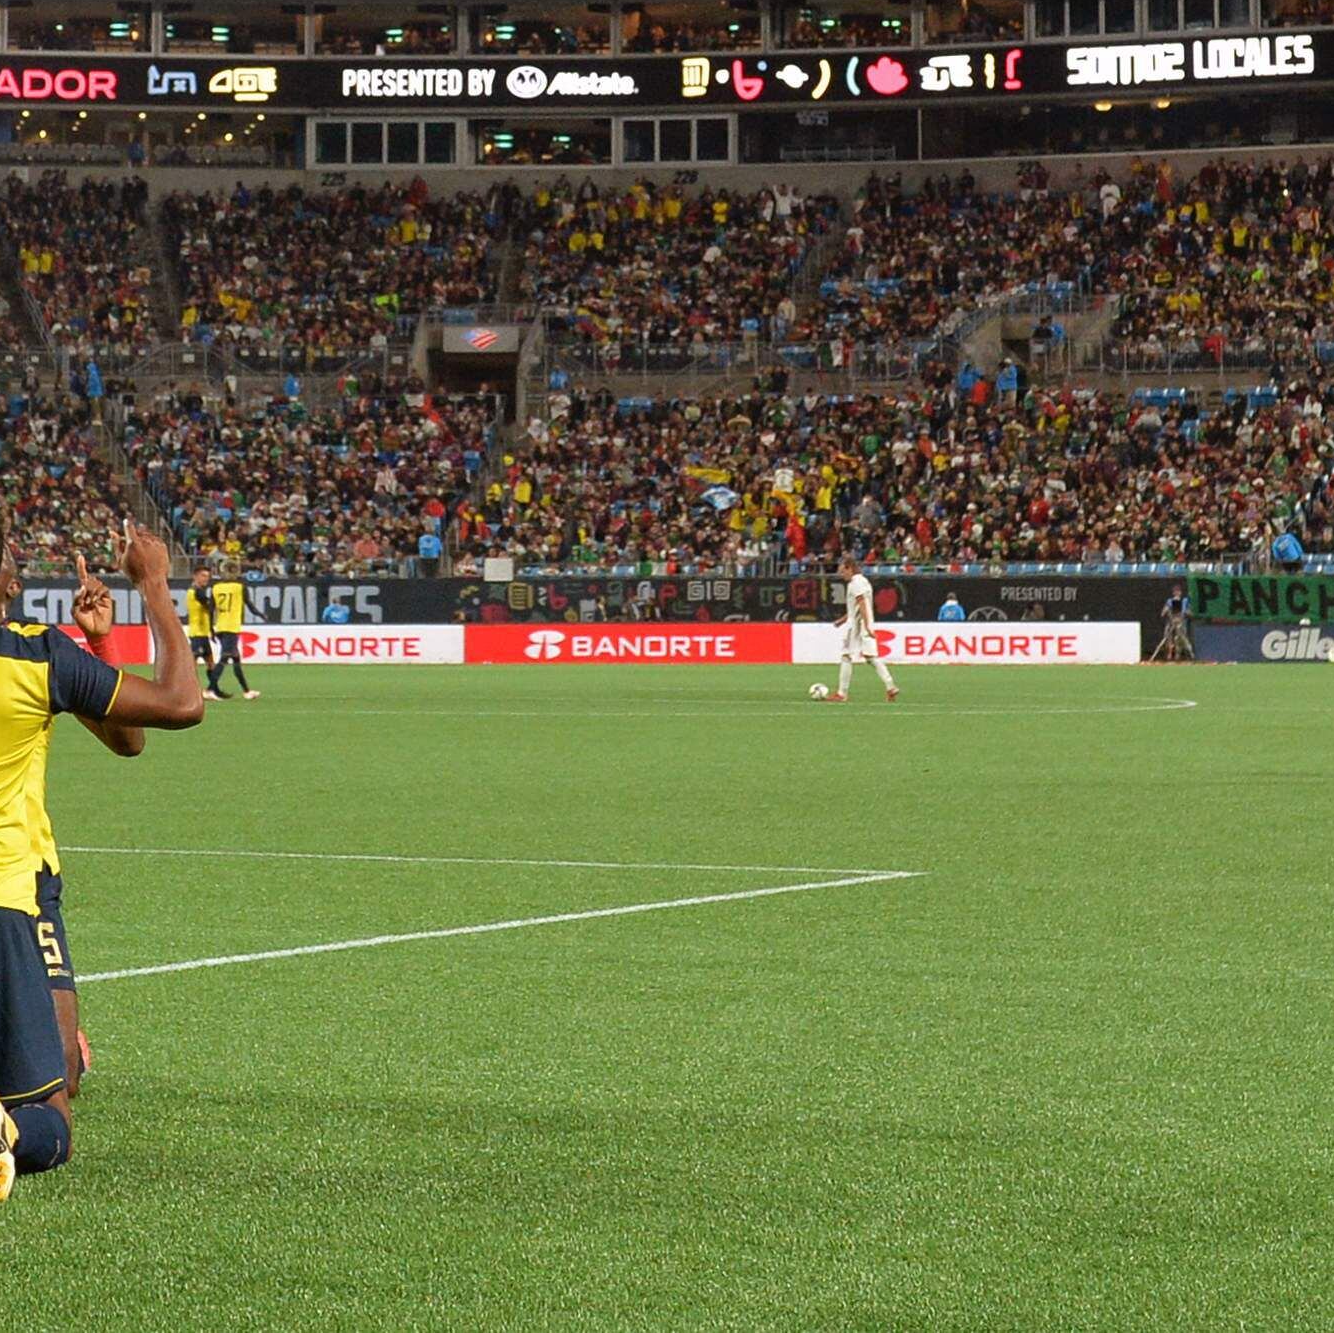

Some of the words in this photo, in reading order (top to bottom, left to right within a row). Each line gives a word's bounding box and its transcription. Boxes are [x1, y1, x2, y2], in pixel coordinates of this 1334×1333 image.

[1192, 34, 1315, 79] LOCALES
[342, 68, 463, 97] PRESENTED
[467, 68, 496, 96] BY
[218, 592, 234, 613] 21
[1001, 586, 1062, 601] PRESENTED
[1064, 586, 1077, 601] BY
[268, 637, 420, 657] BANORTE
[572, 636, 735, 658] BANORTE
[904, 636, 1077, 656] BANORTE
[37, 921, 64, 965] 5
